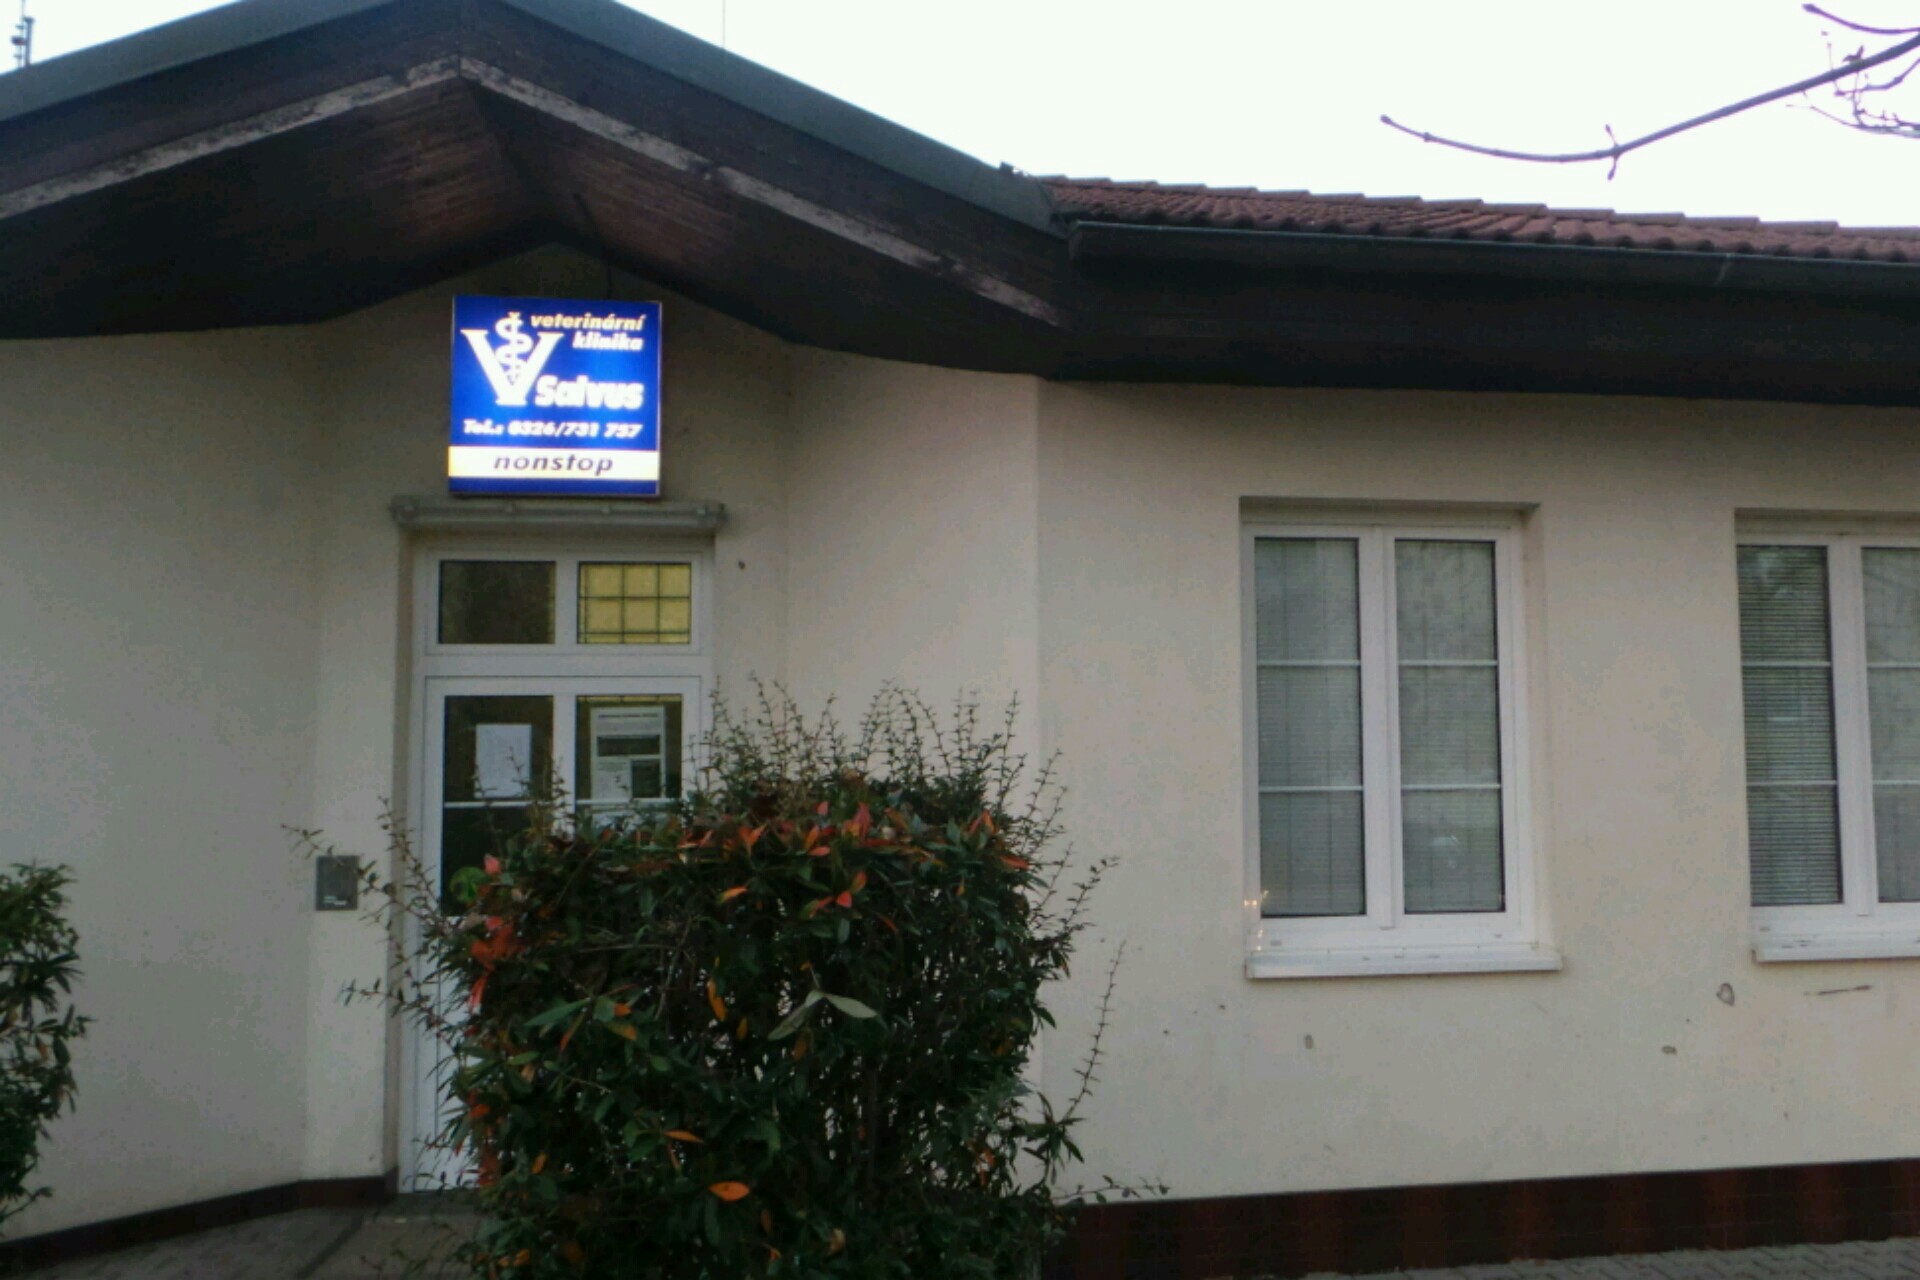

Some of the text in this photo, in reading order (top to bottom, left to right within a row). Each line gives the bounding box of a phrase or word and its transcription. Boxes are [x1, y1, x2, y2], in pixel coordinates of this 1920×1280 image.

[531, 312, 646, 331] veterinární
[573, 331, 644, 350] klinika
[535, 375, 645, 409] Salvus
[494, 454, 613, 476] nonstop
